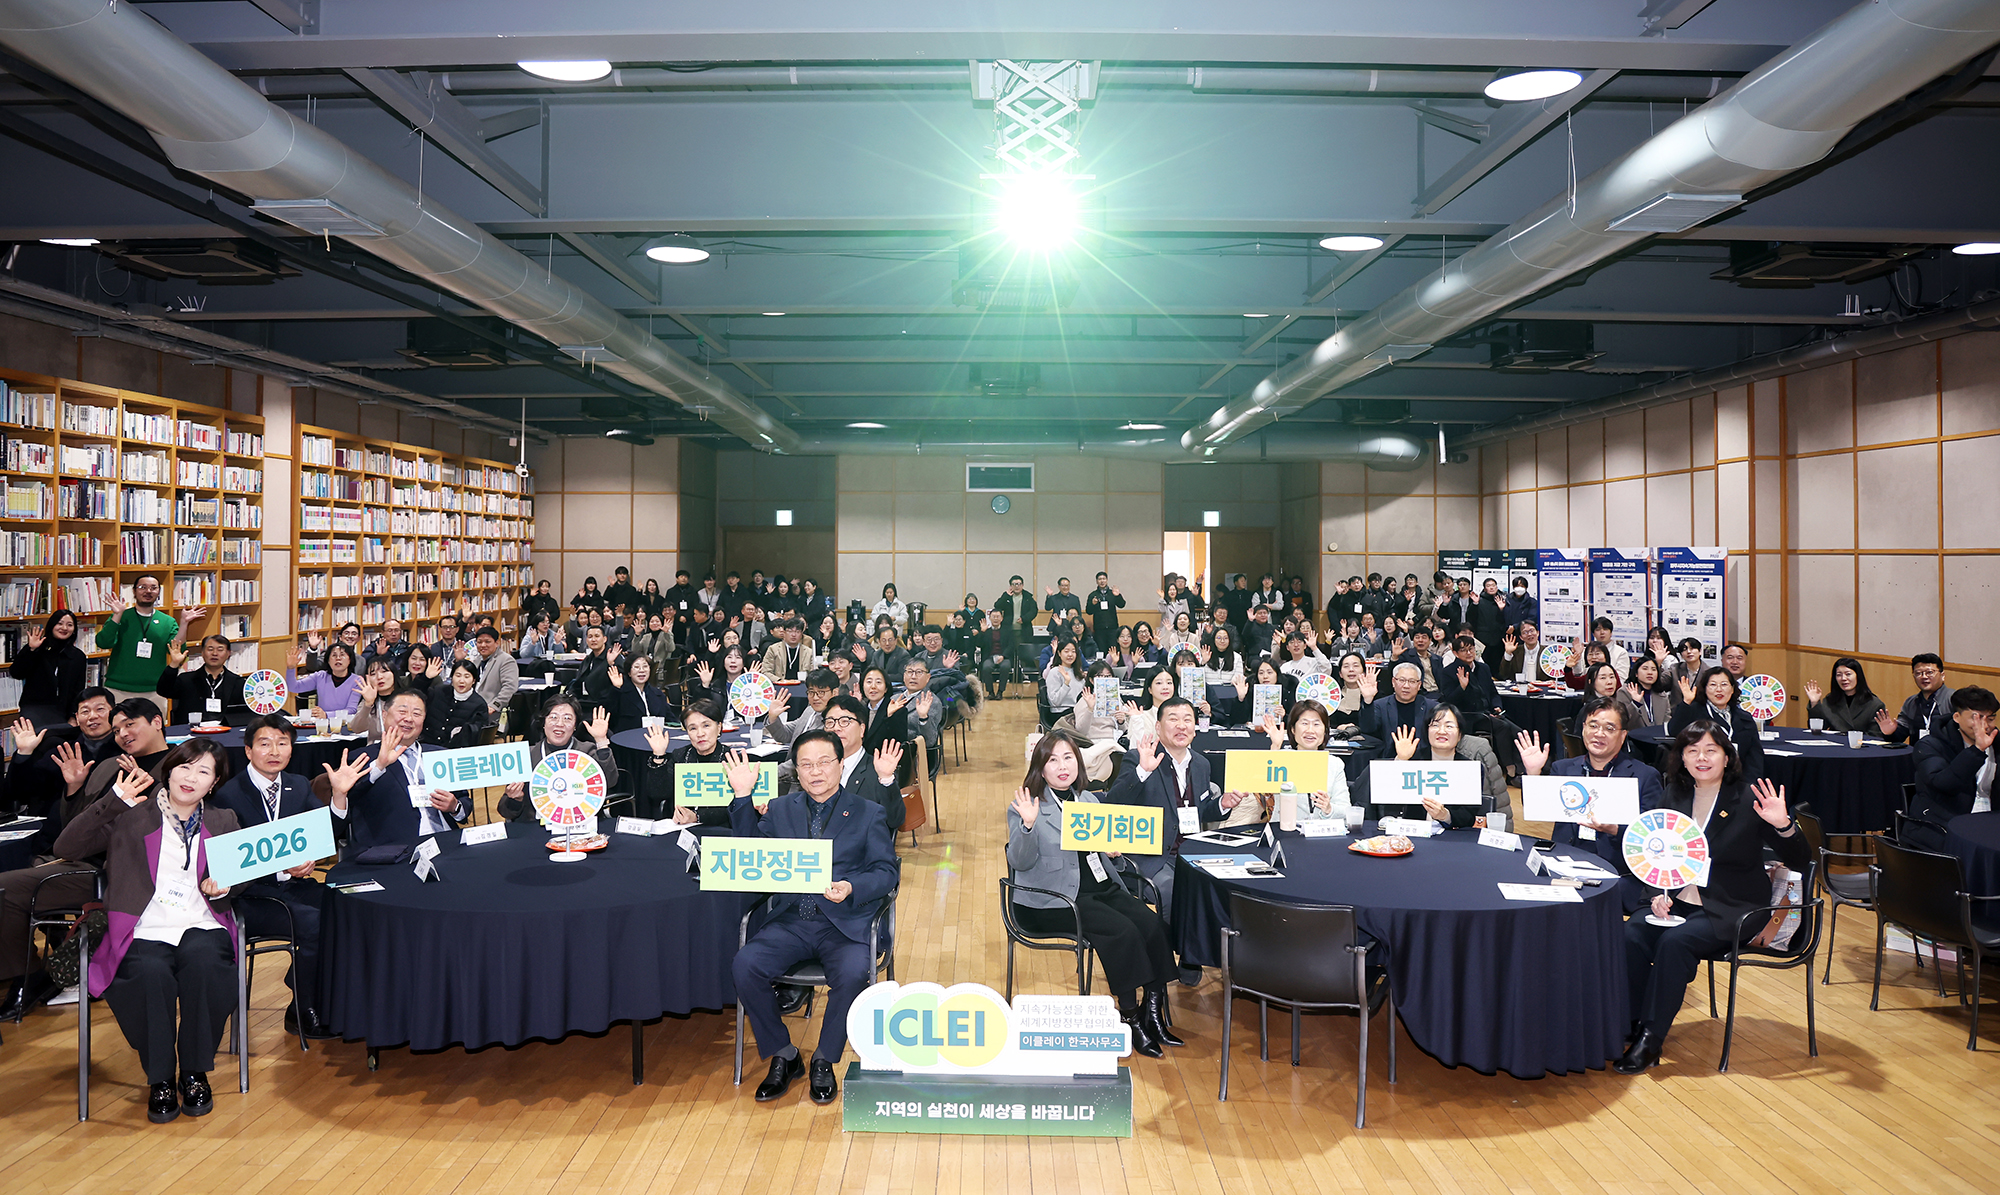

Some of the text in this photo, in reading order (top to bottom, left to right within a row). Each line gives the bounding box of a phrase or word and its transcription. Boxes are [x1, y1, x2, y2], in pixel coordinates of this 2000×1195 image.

[432, 750, 524, 781] 이클레이
[1267, 760, 1287, 782] in
[682, 771, 770, 797] 한국원
[1401, 770, 1449, 796] 파주
[1070, 812, 1155, 845] 정기회의
[237, 827, 308, 869] 2026
[711, 848, 822, 882] 지방정부
[1020, 1004, 1108, 1016] 지속가능성을 위한
[1020, 1017, 1115, 1029] 세계지방정부협의회
[874, 1009, 985, 1047] ICLEI
[1022, 1035, 1122, 1048] 이클레이 한국사무소
[875, 1101, 1095, 1121] 지역의 실천이 세상을 바꿉니다
